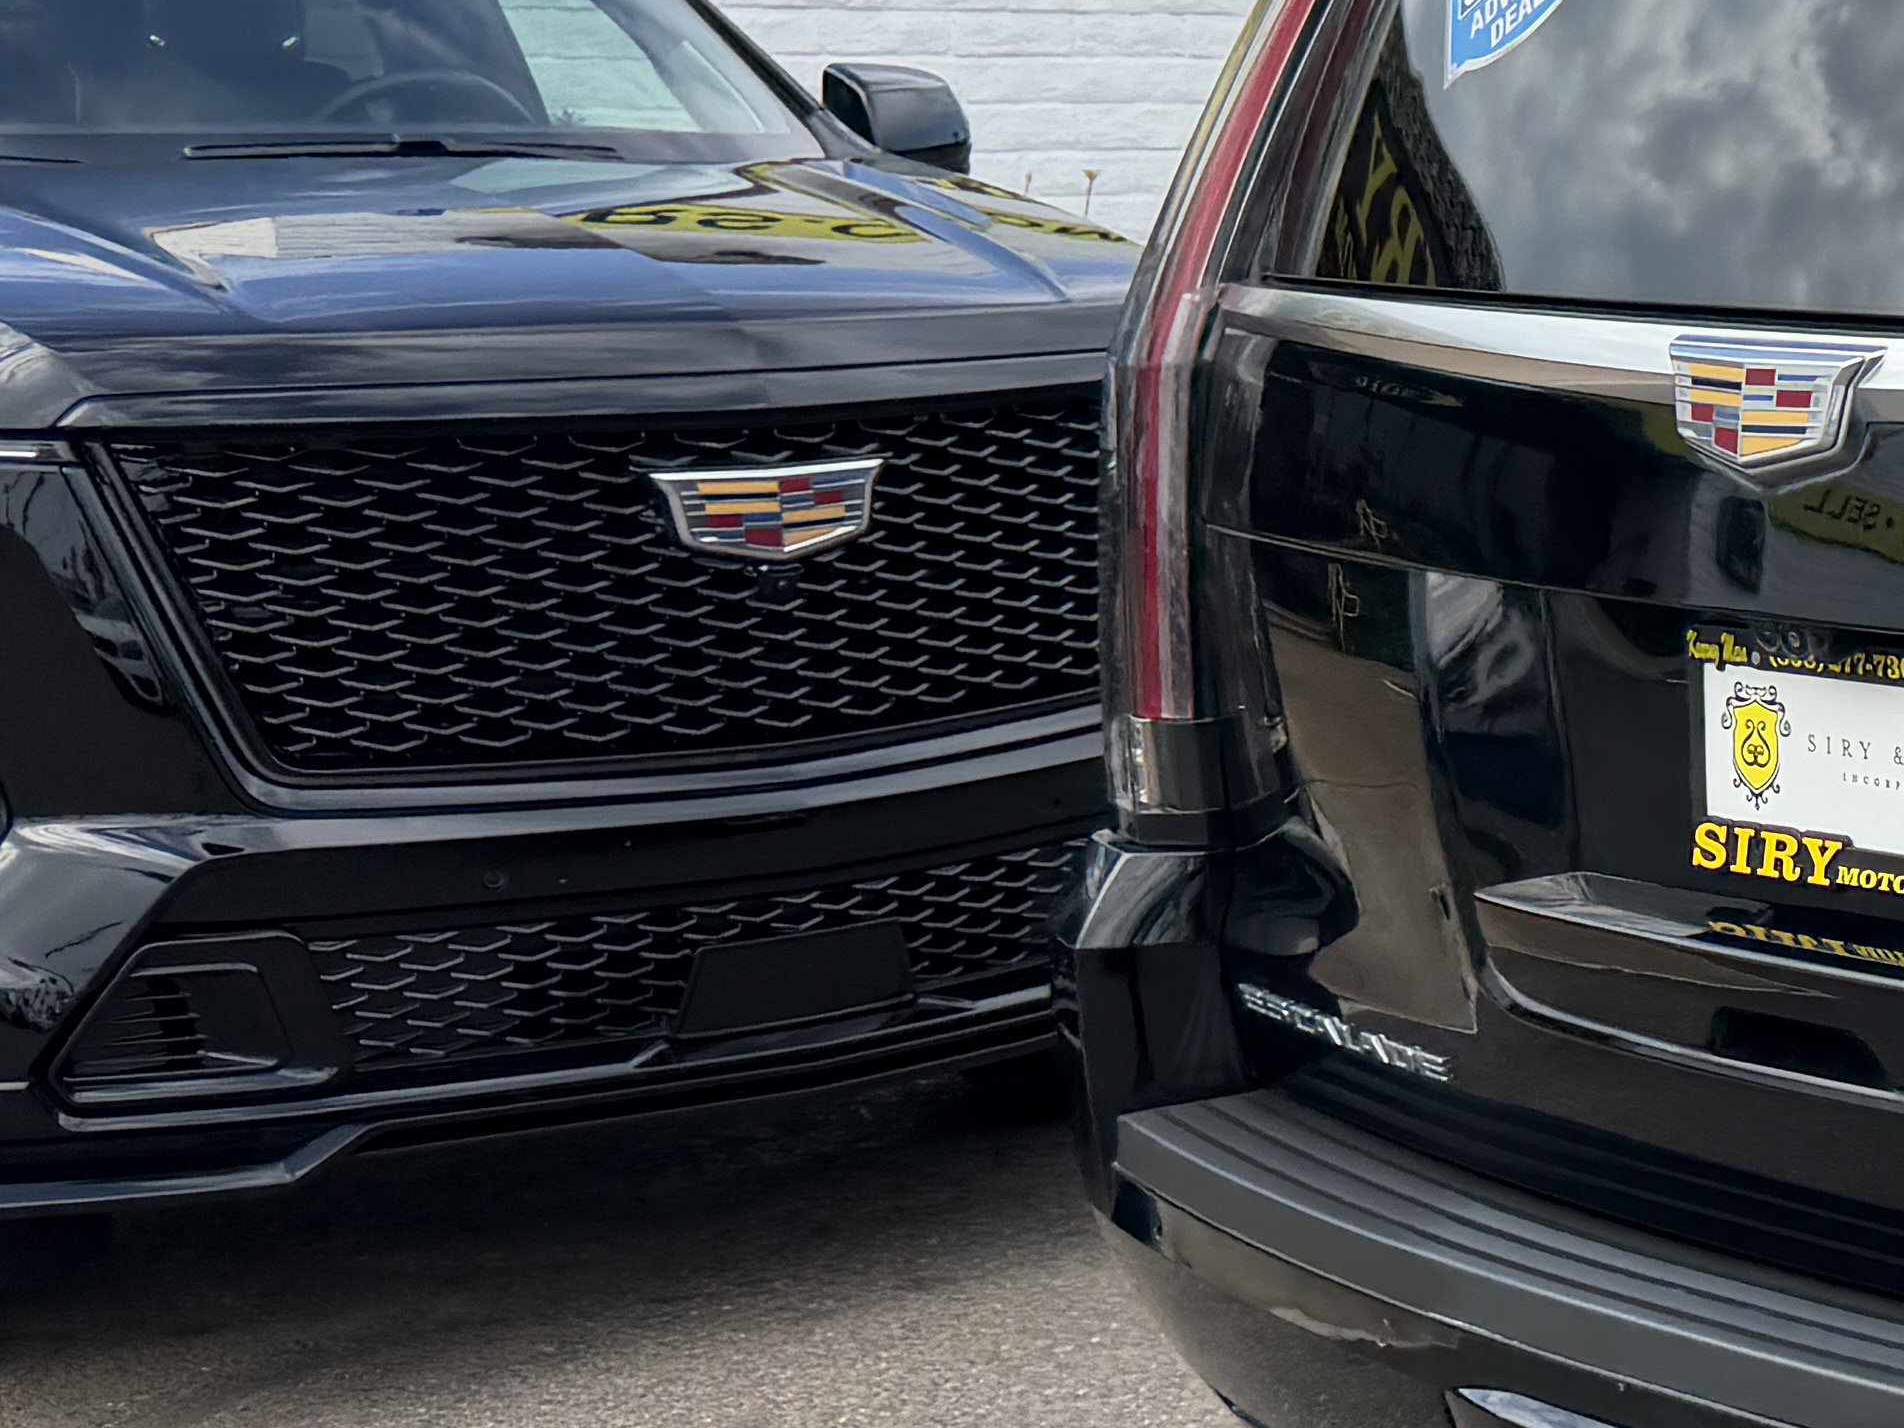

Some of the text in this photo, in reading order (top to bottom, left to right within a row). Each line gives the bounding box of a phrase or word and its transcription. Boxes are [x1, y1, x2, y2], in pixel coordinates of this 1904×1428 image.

[1807, 733, 1872, 761] SIRY
[1893, 745, 1904, 766] &
[1692, 821, 1843, 887] SIRY
